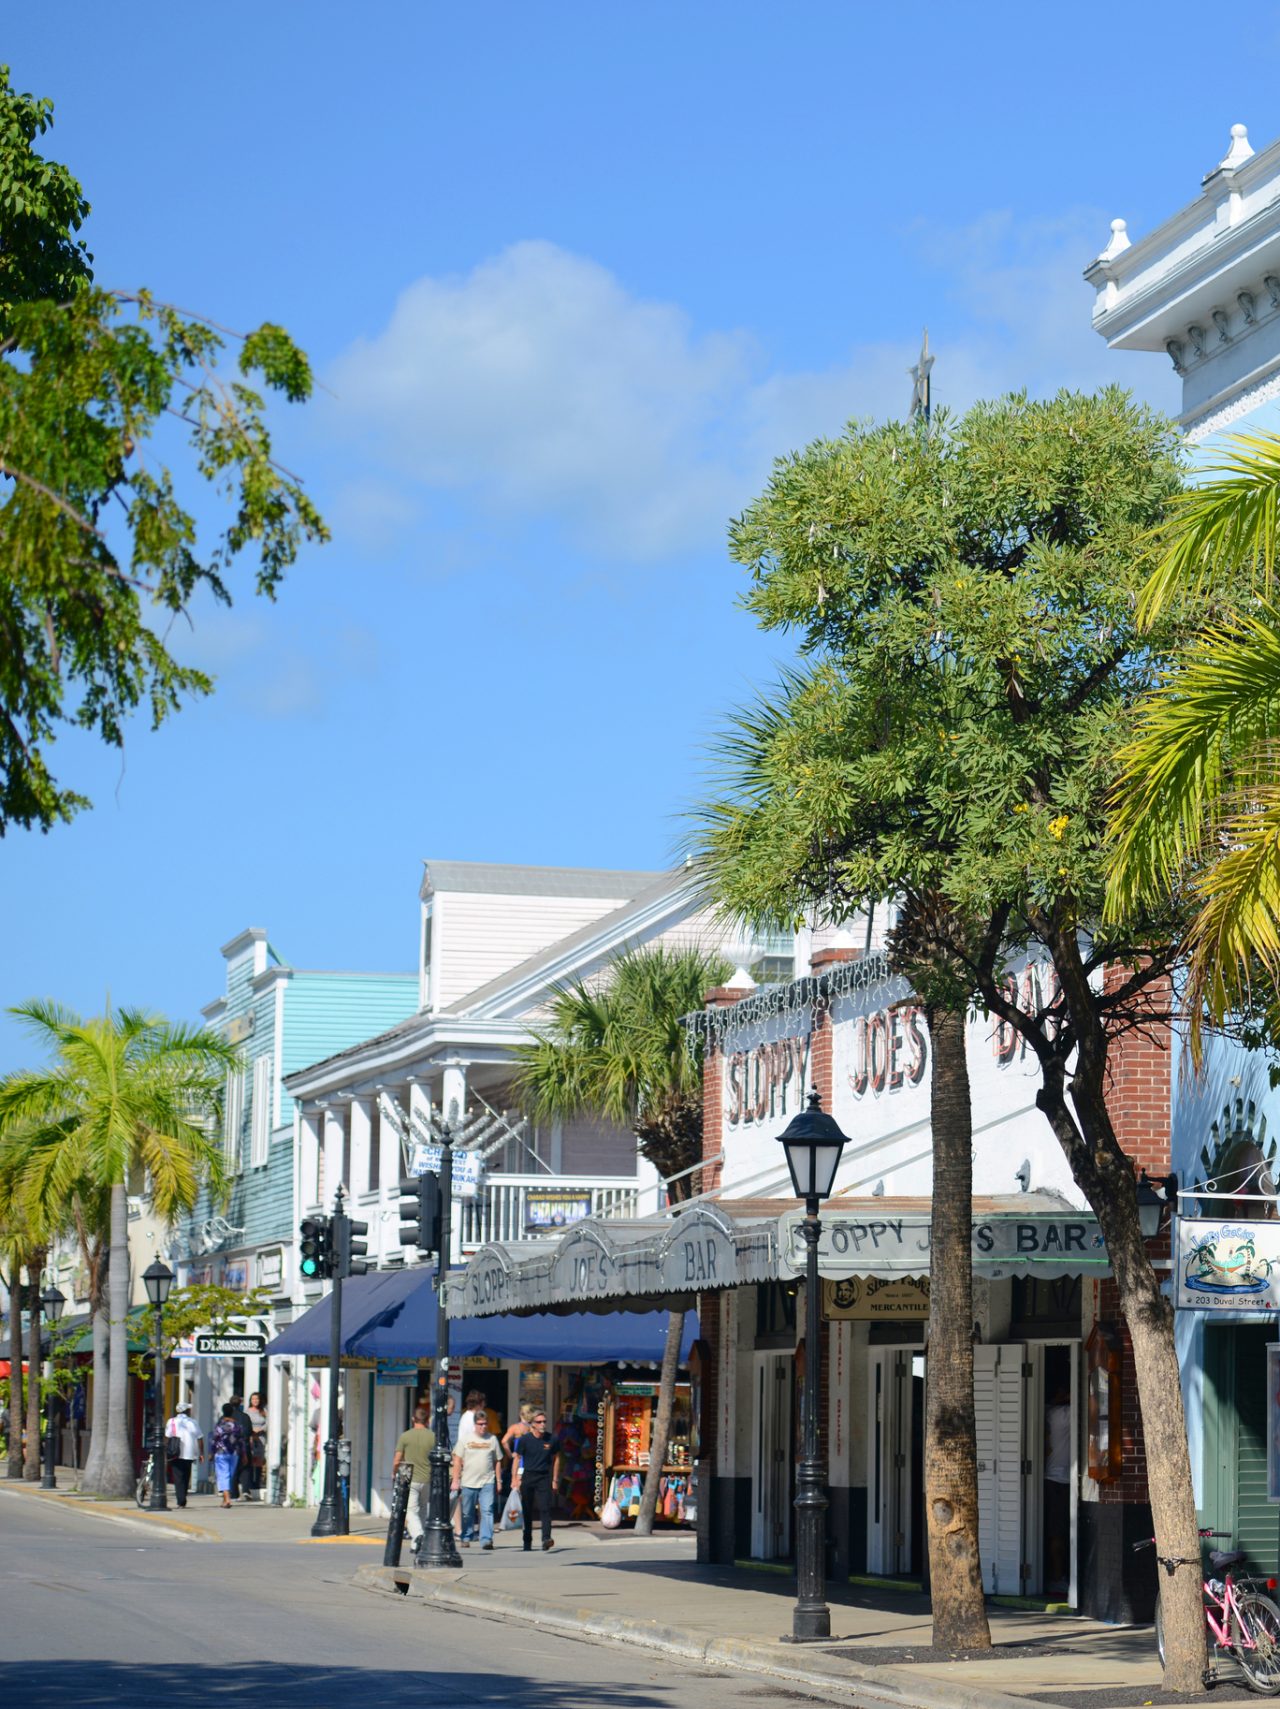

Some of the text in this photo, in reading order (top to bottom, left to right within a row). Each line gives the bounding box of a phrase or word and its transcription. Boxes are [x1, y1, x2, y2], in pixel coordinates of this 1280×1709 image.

[724, 1032, 811, 1126] SLOPPY
[794, 1218, 903, 1257] SOPPY
[1017, 1224, 1088, 1252] BAR
[569, 1250, 608, 1293] JOE'S
[684, 1239, 718, 1282] BAR
[870, 1304, 928, 1312] MERCANTILE
[1195, 1296, 1211, 1304] 203
[1213, 1296, 1235, 1305] Duval
[1237, 1296, 1264, 1306] Street
